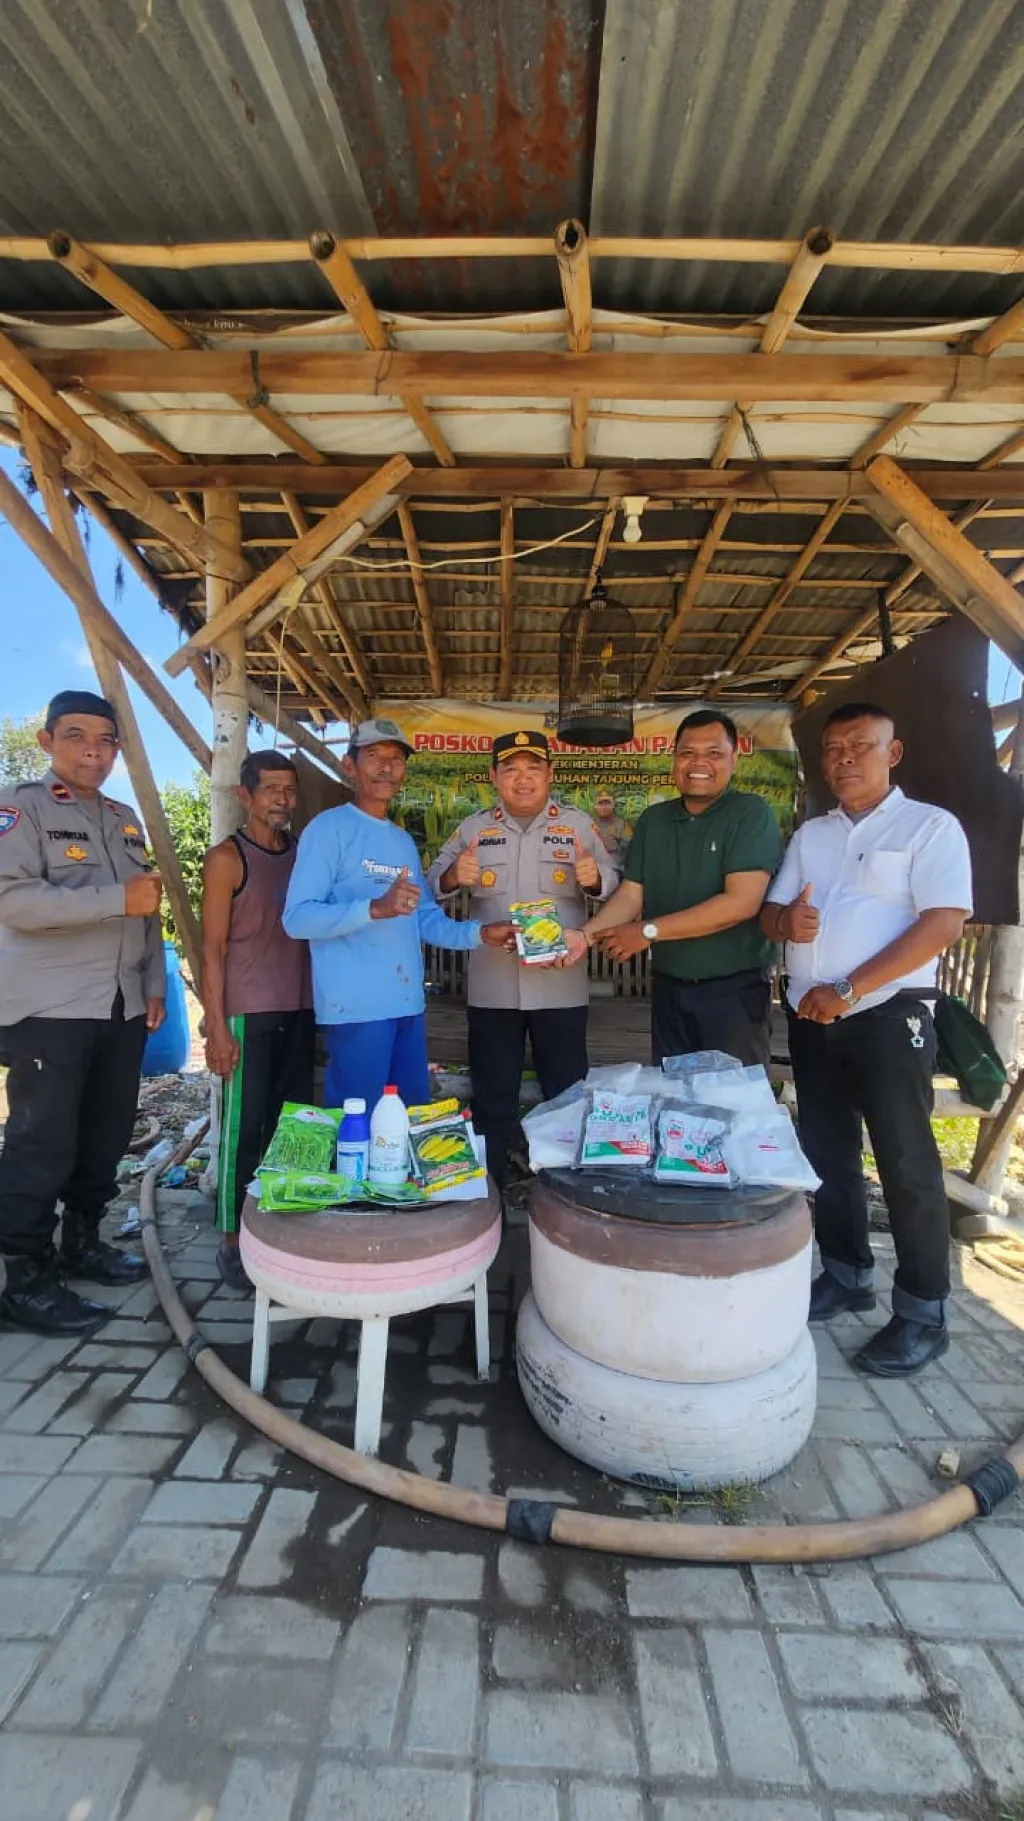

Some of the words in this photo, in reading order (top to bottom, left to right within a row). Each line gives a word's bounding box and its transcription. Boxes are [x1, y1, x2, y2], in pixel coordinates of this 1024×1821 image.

[413, 733, 493, 754] POSKO
[592, 774, 651, 784] TANJUNG
[543, 836, 574, 846] POLR
